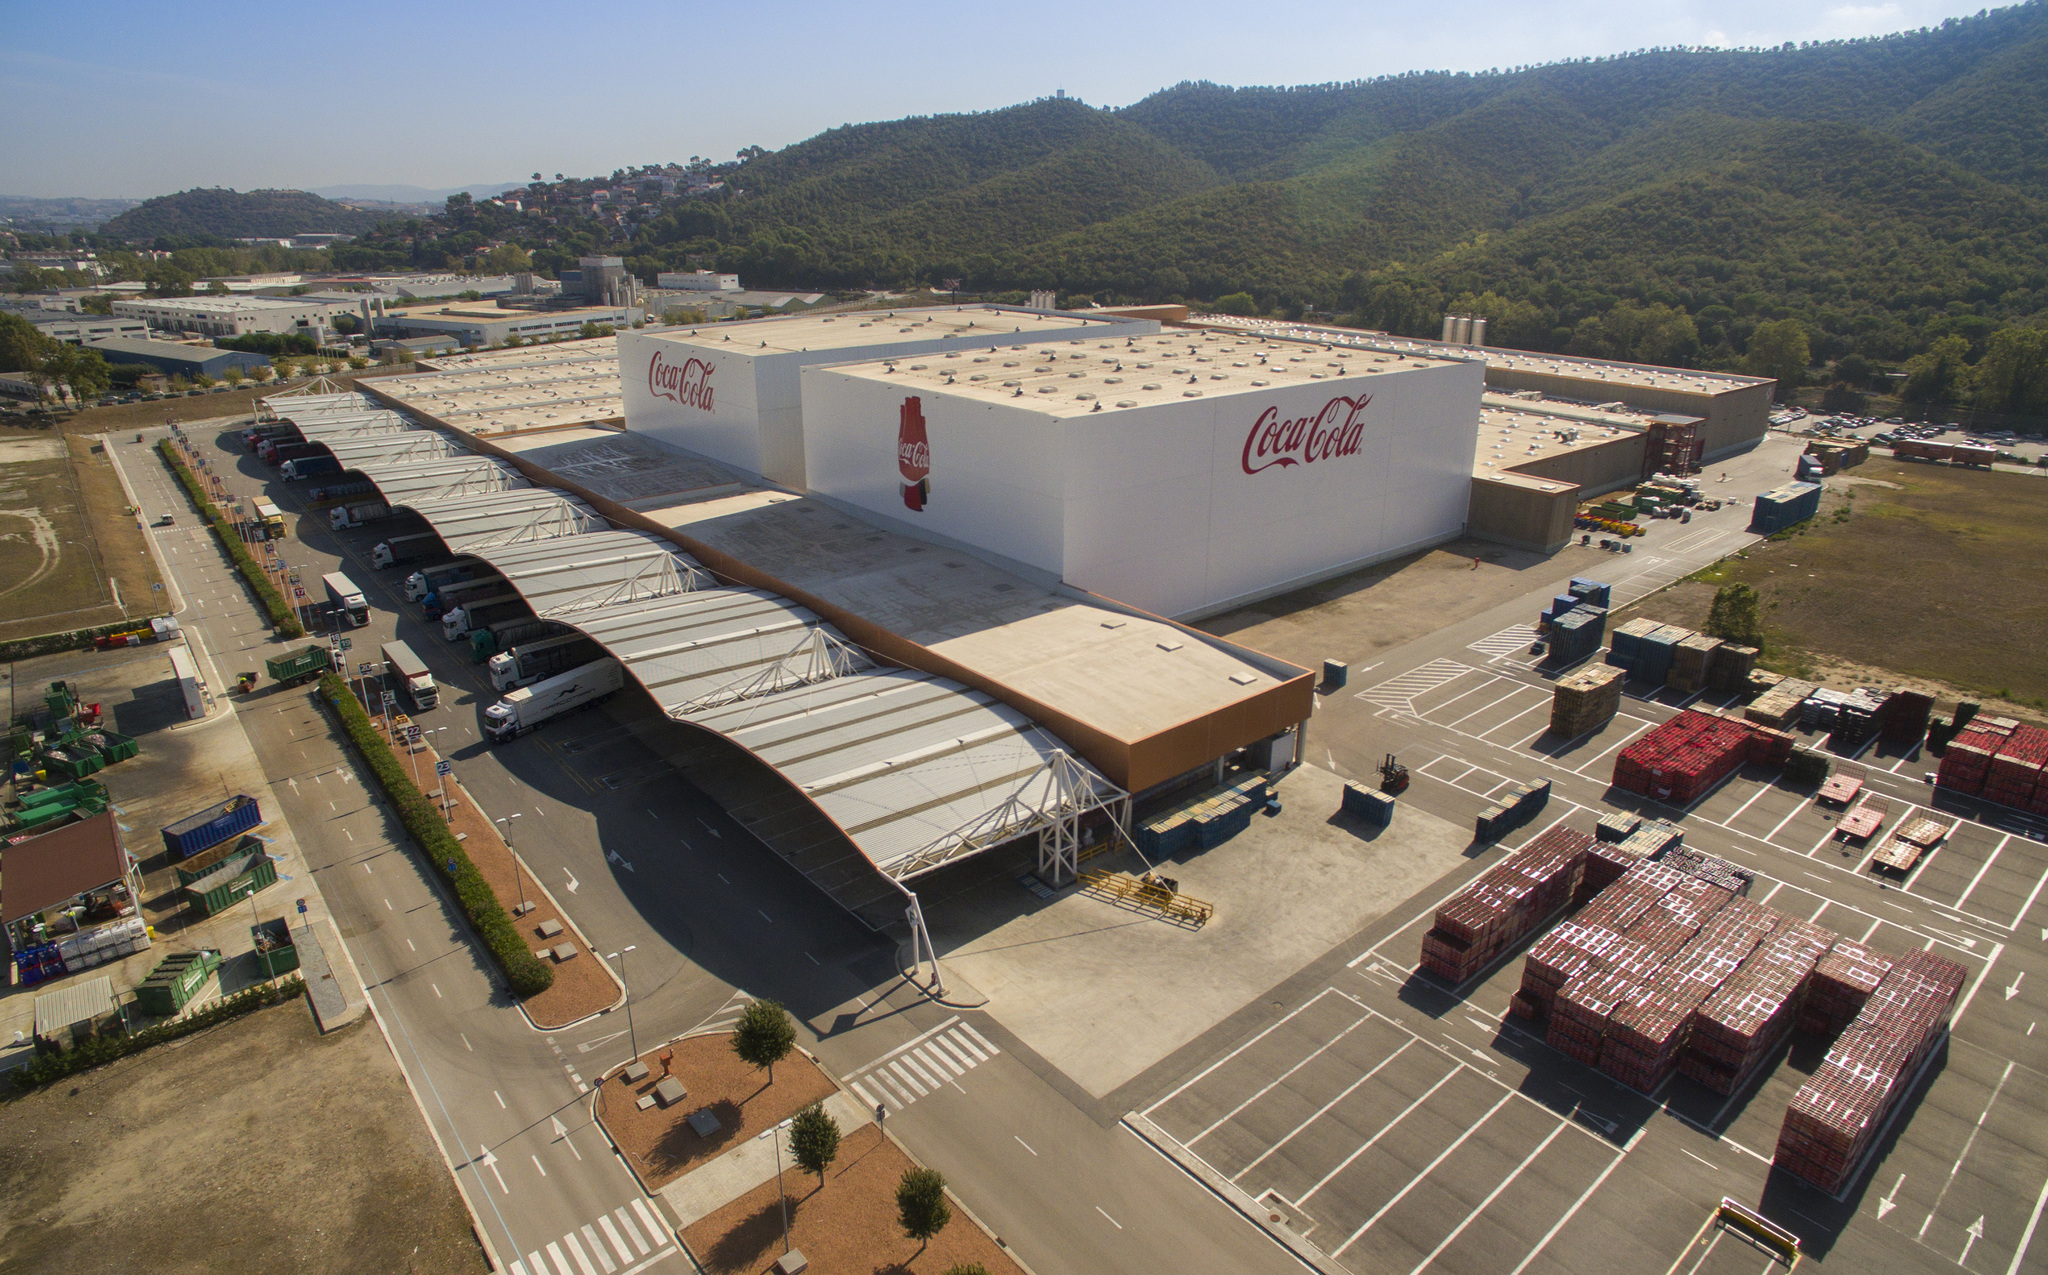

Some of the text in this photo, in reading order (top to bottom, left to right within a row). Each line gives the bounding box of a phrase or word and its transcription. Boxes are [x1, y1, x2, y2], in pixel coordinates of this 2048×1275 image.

[648, 350, 717, 411] Coca-Cola
[1242, 392, 1374, 475] Coca-Cola
[408, 726, 420, 735] 22
[437, 763, 449, 771] 23
